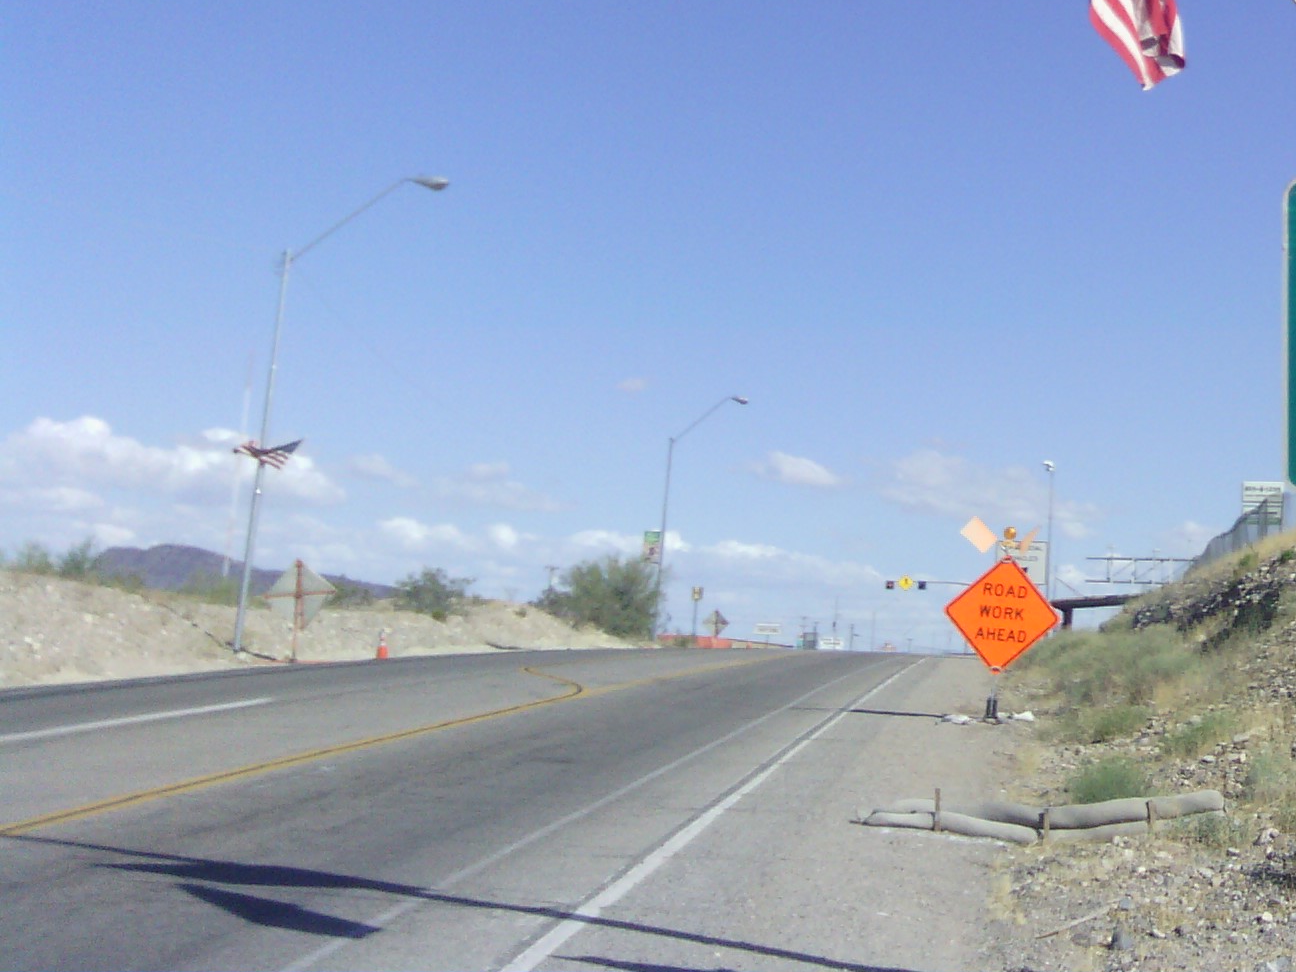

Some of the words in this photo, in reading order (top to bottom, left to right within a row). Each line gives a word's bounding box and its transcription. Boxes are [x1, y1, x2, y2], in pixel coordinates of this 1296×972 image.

[982, 582, 1028, 599] ROAD
[979, 604, 1025, 620] WORK
[975, 627, 1027, 643] AHEAD
